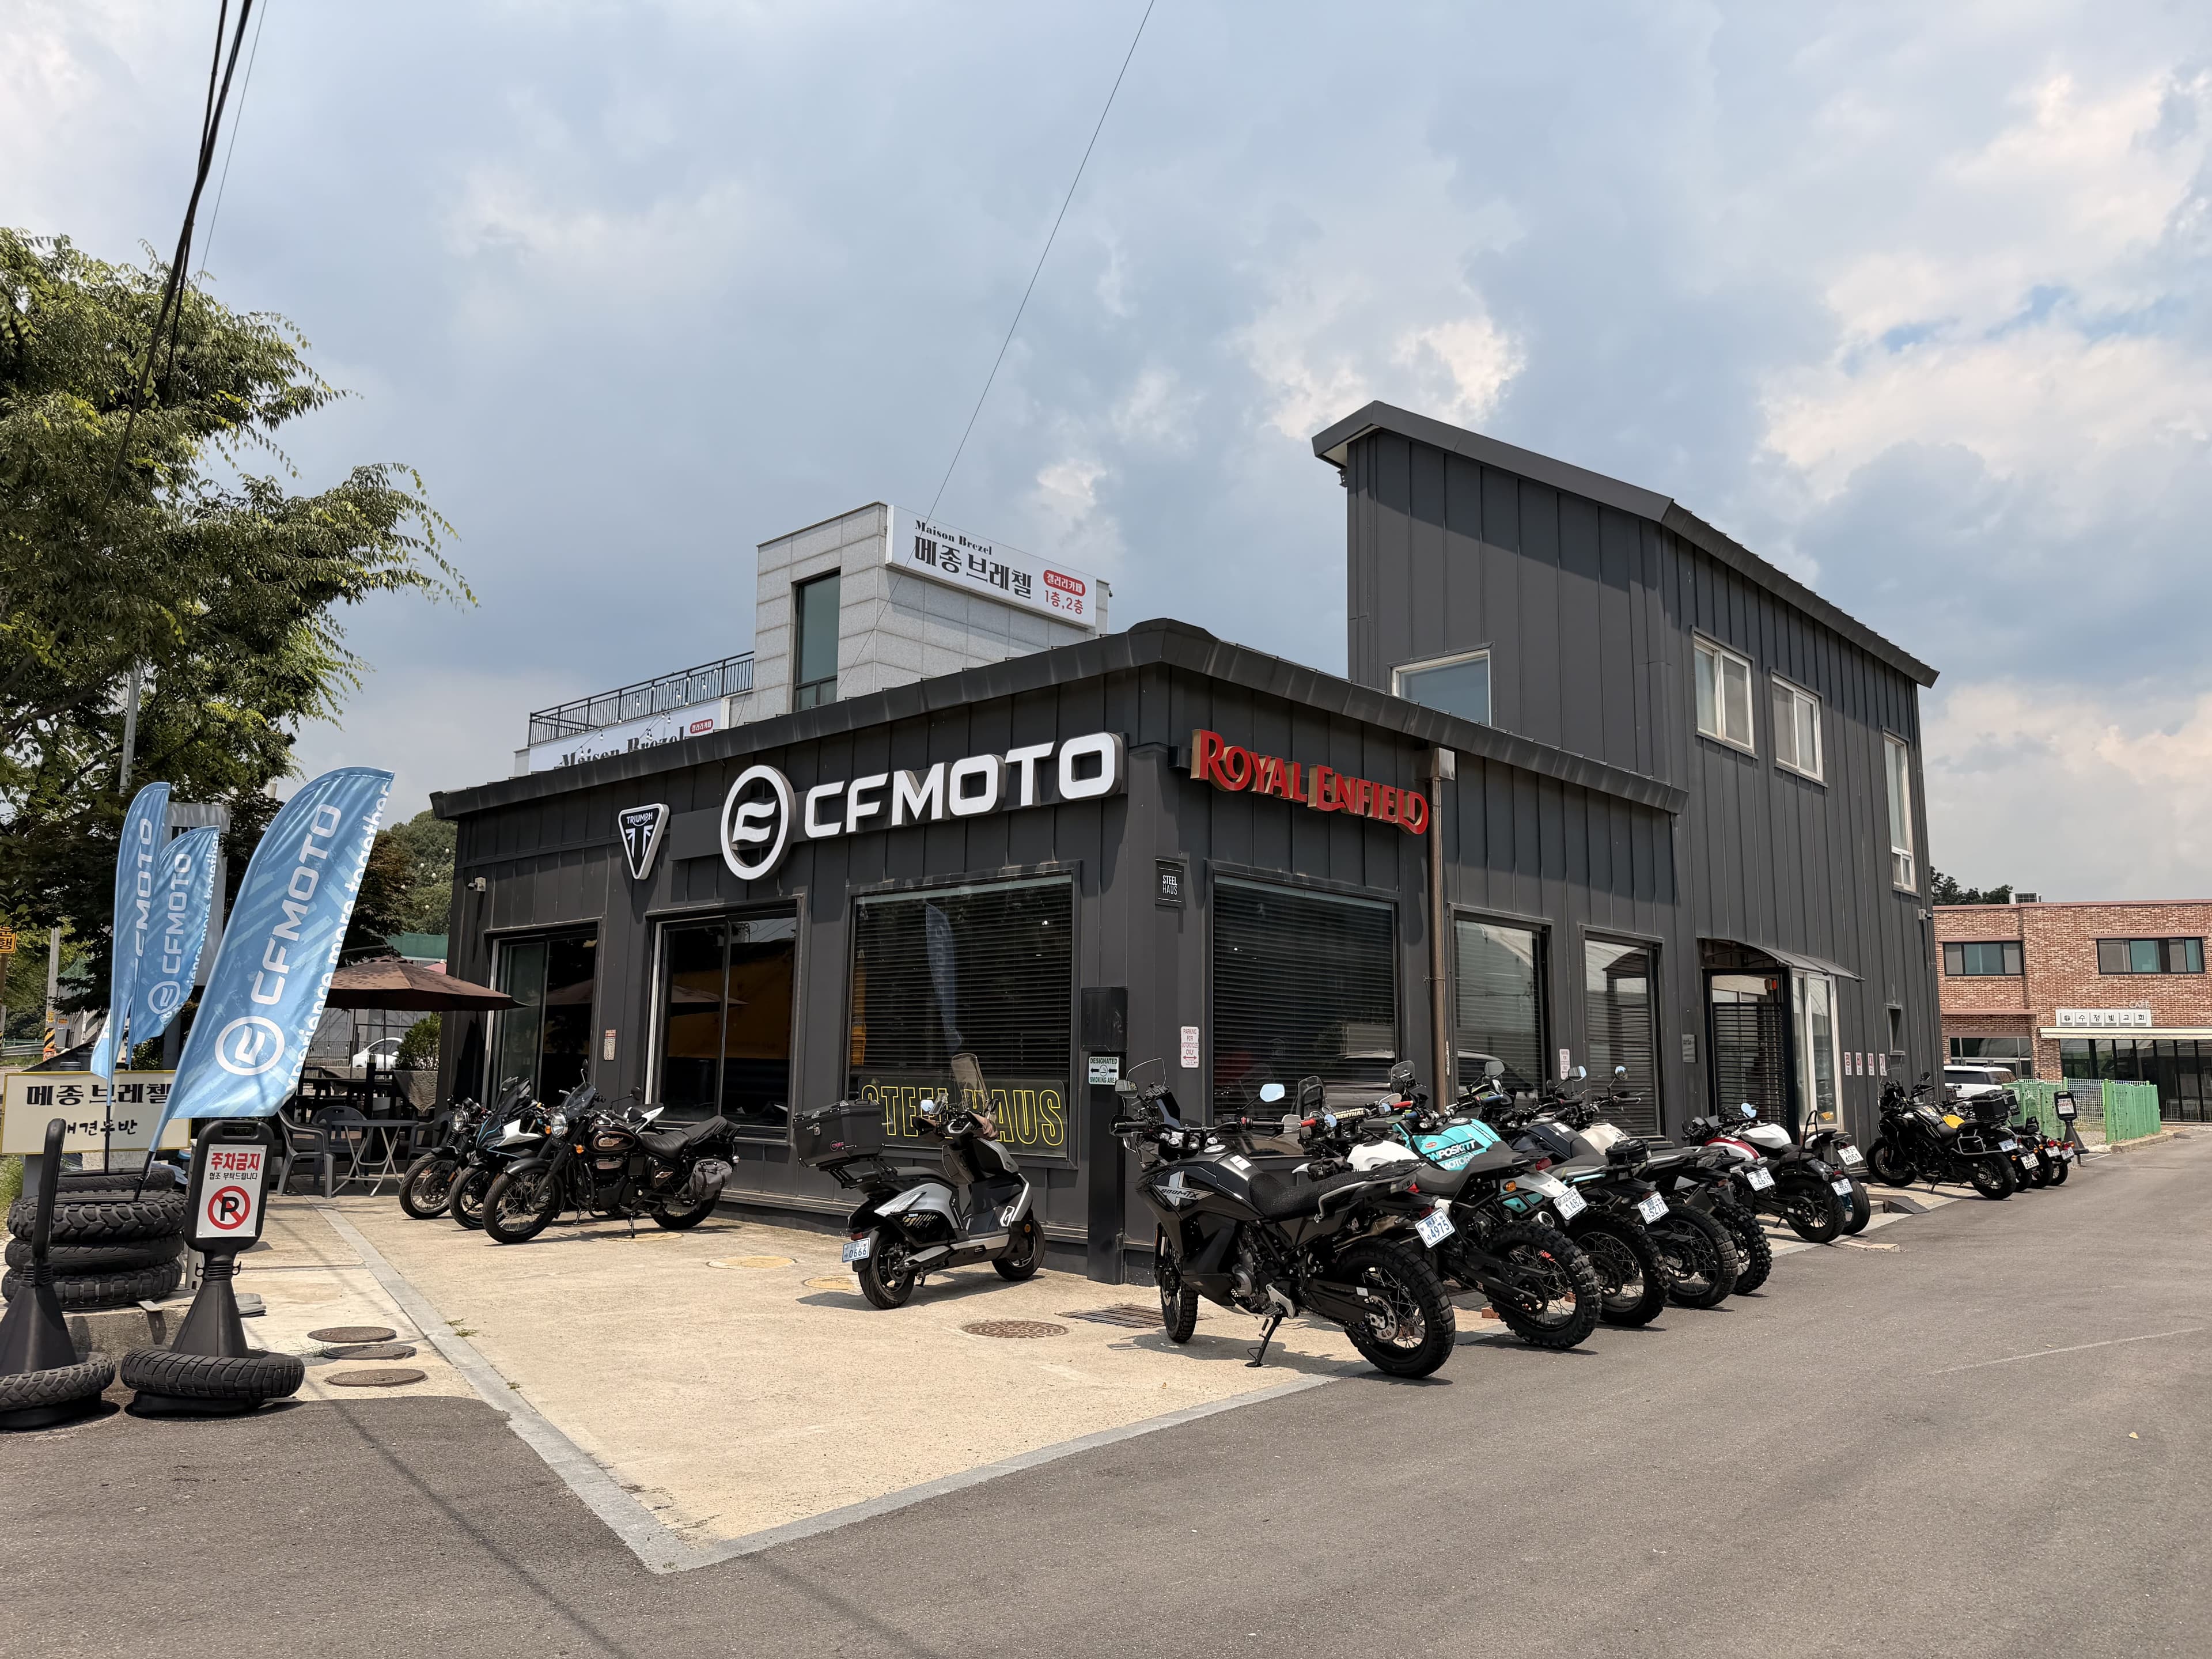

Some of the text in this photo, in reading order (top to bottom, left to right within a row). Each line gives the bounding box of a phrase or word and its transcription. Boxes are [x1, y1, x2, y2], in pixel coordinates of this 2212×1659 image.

[915, 520, 992, 555] Maison Brezel
[1046, 573, 1083, 594] 갤러리카페
[805, 732, 1123, 839] CFMOTO
[1190, 729, 1429, 835] ROYAL ENFIELD
[626, 812, 653, 827] TRIUMPH
[1162, 874, 1178, 886] STEEL
[1162, 884, 1178, 895] HAUS
[162, 853, 191, 974] CFMOTO
[251, 804, 341, 1005] CFMOTO
[26, 1085, 84, 1106] 메종
[211, 1153, 261, 1171] 주차금지
[2025, 1159, 2037, 1168] 2233
